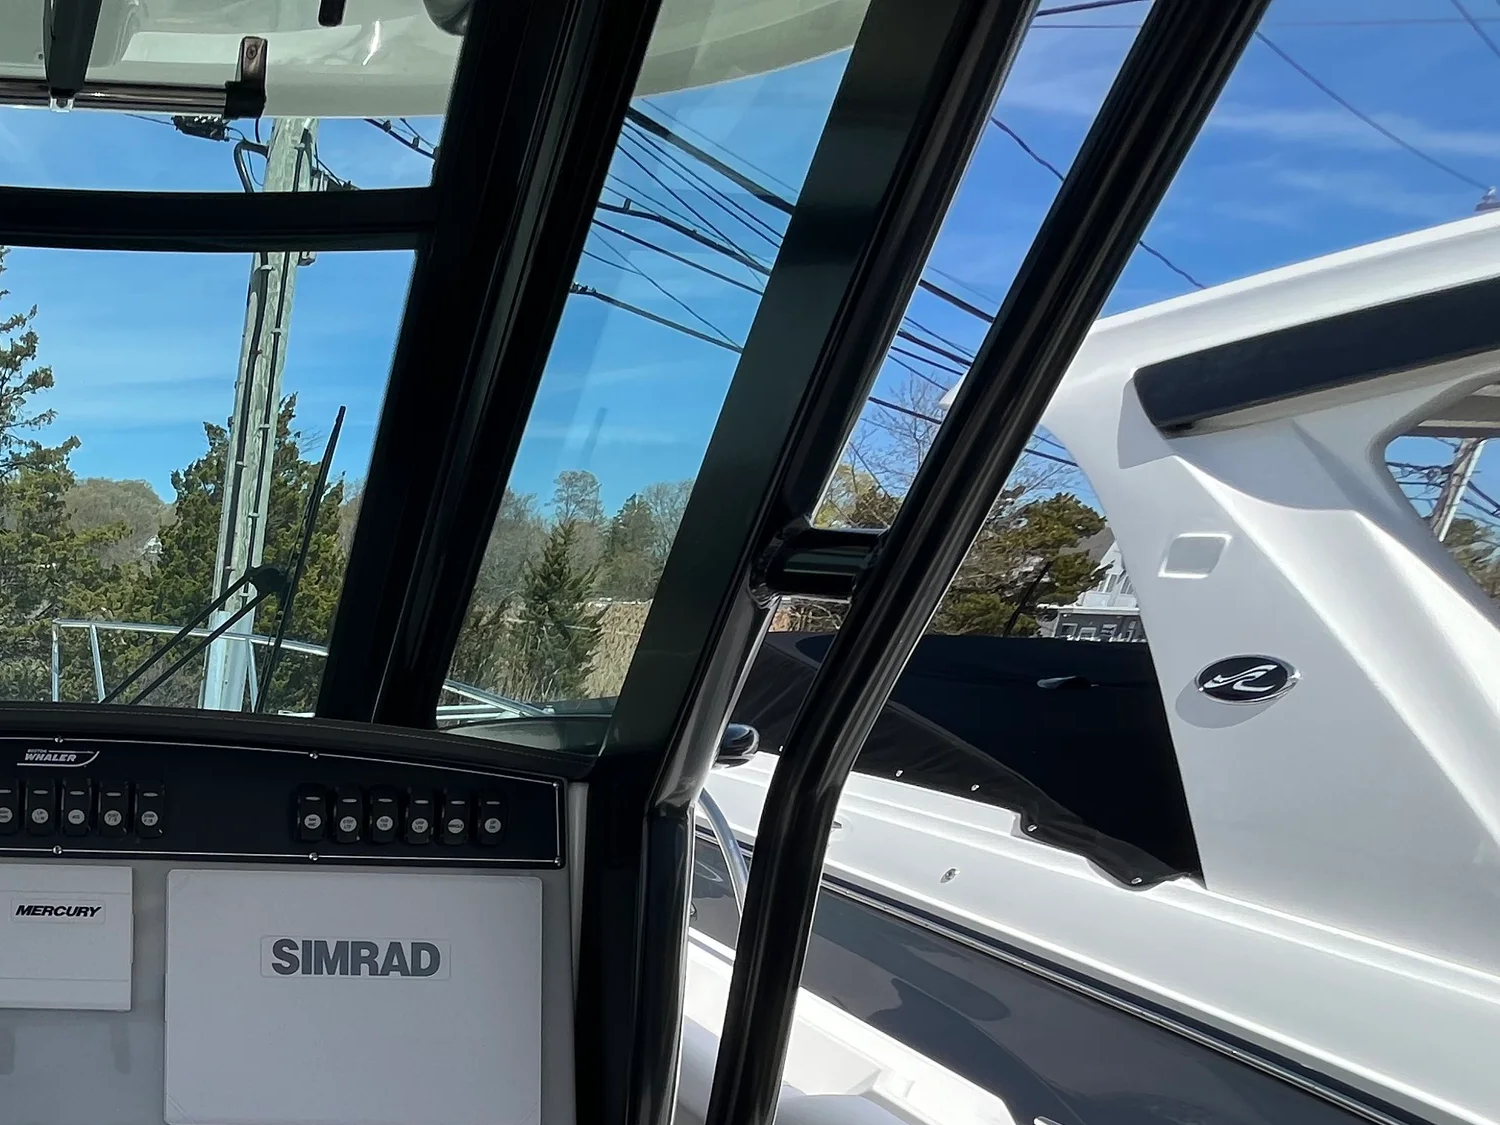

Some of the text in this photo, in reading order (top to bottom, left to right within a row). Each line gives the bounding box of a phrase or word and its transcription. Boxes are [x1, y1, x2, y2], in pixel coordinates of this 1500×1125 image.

[24, 752, 77, 762] WHALER
[15, 904, 102, 918] MERCURY
[271, 938, 441, 977] SIMRAD
